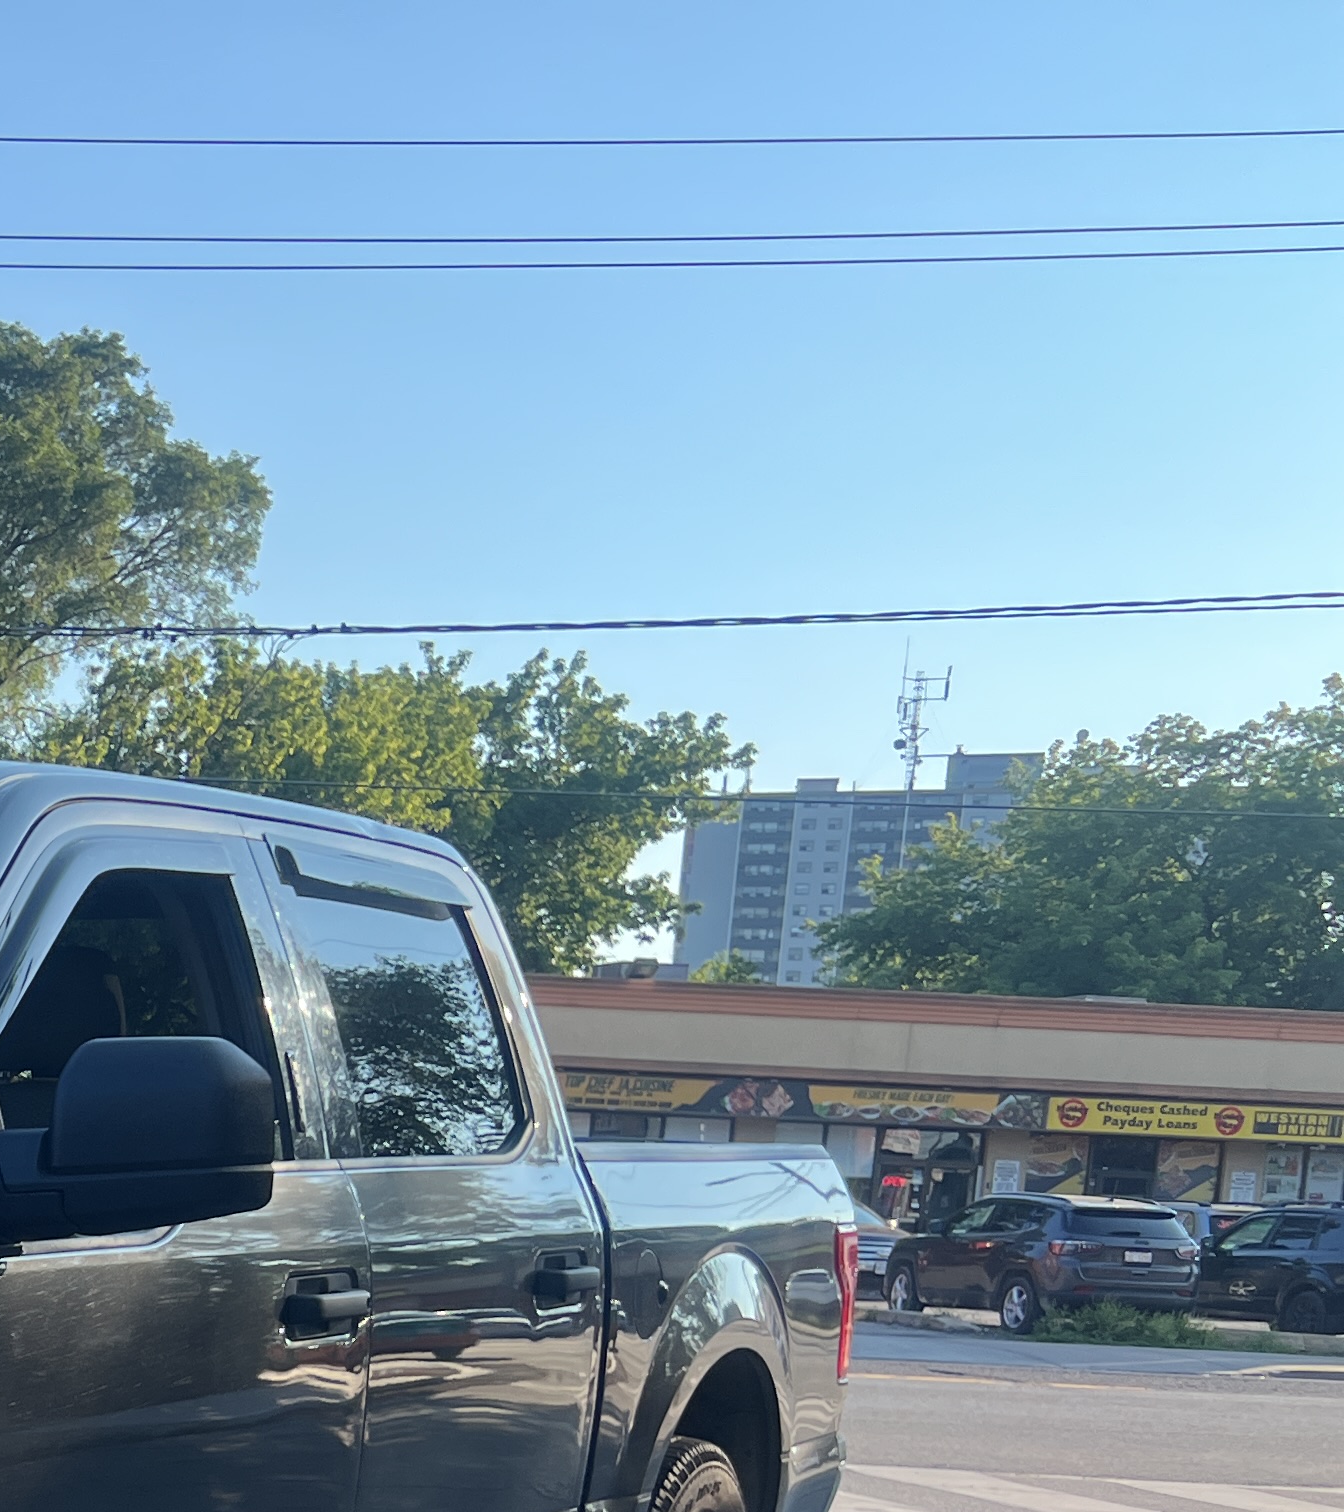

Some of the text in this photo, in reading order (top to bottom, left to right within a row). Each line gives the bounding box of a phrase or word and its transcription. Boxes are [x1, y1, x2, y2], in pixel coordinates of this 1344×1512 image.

[1097, 1101, 1155, 1116] Cheques
[1159, 1104, 1209, 1117] Cashed
[1102, 1115, 1153, 1131] Payday
[1157, 1118, 1198, 1130] Loans
[1256, 1112, 1329, 1126] WESTERN
[1278, 1123, 1328, 1136] UNION
